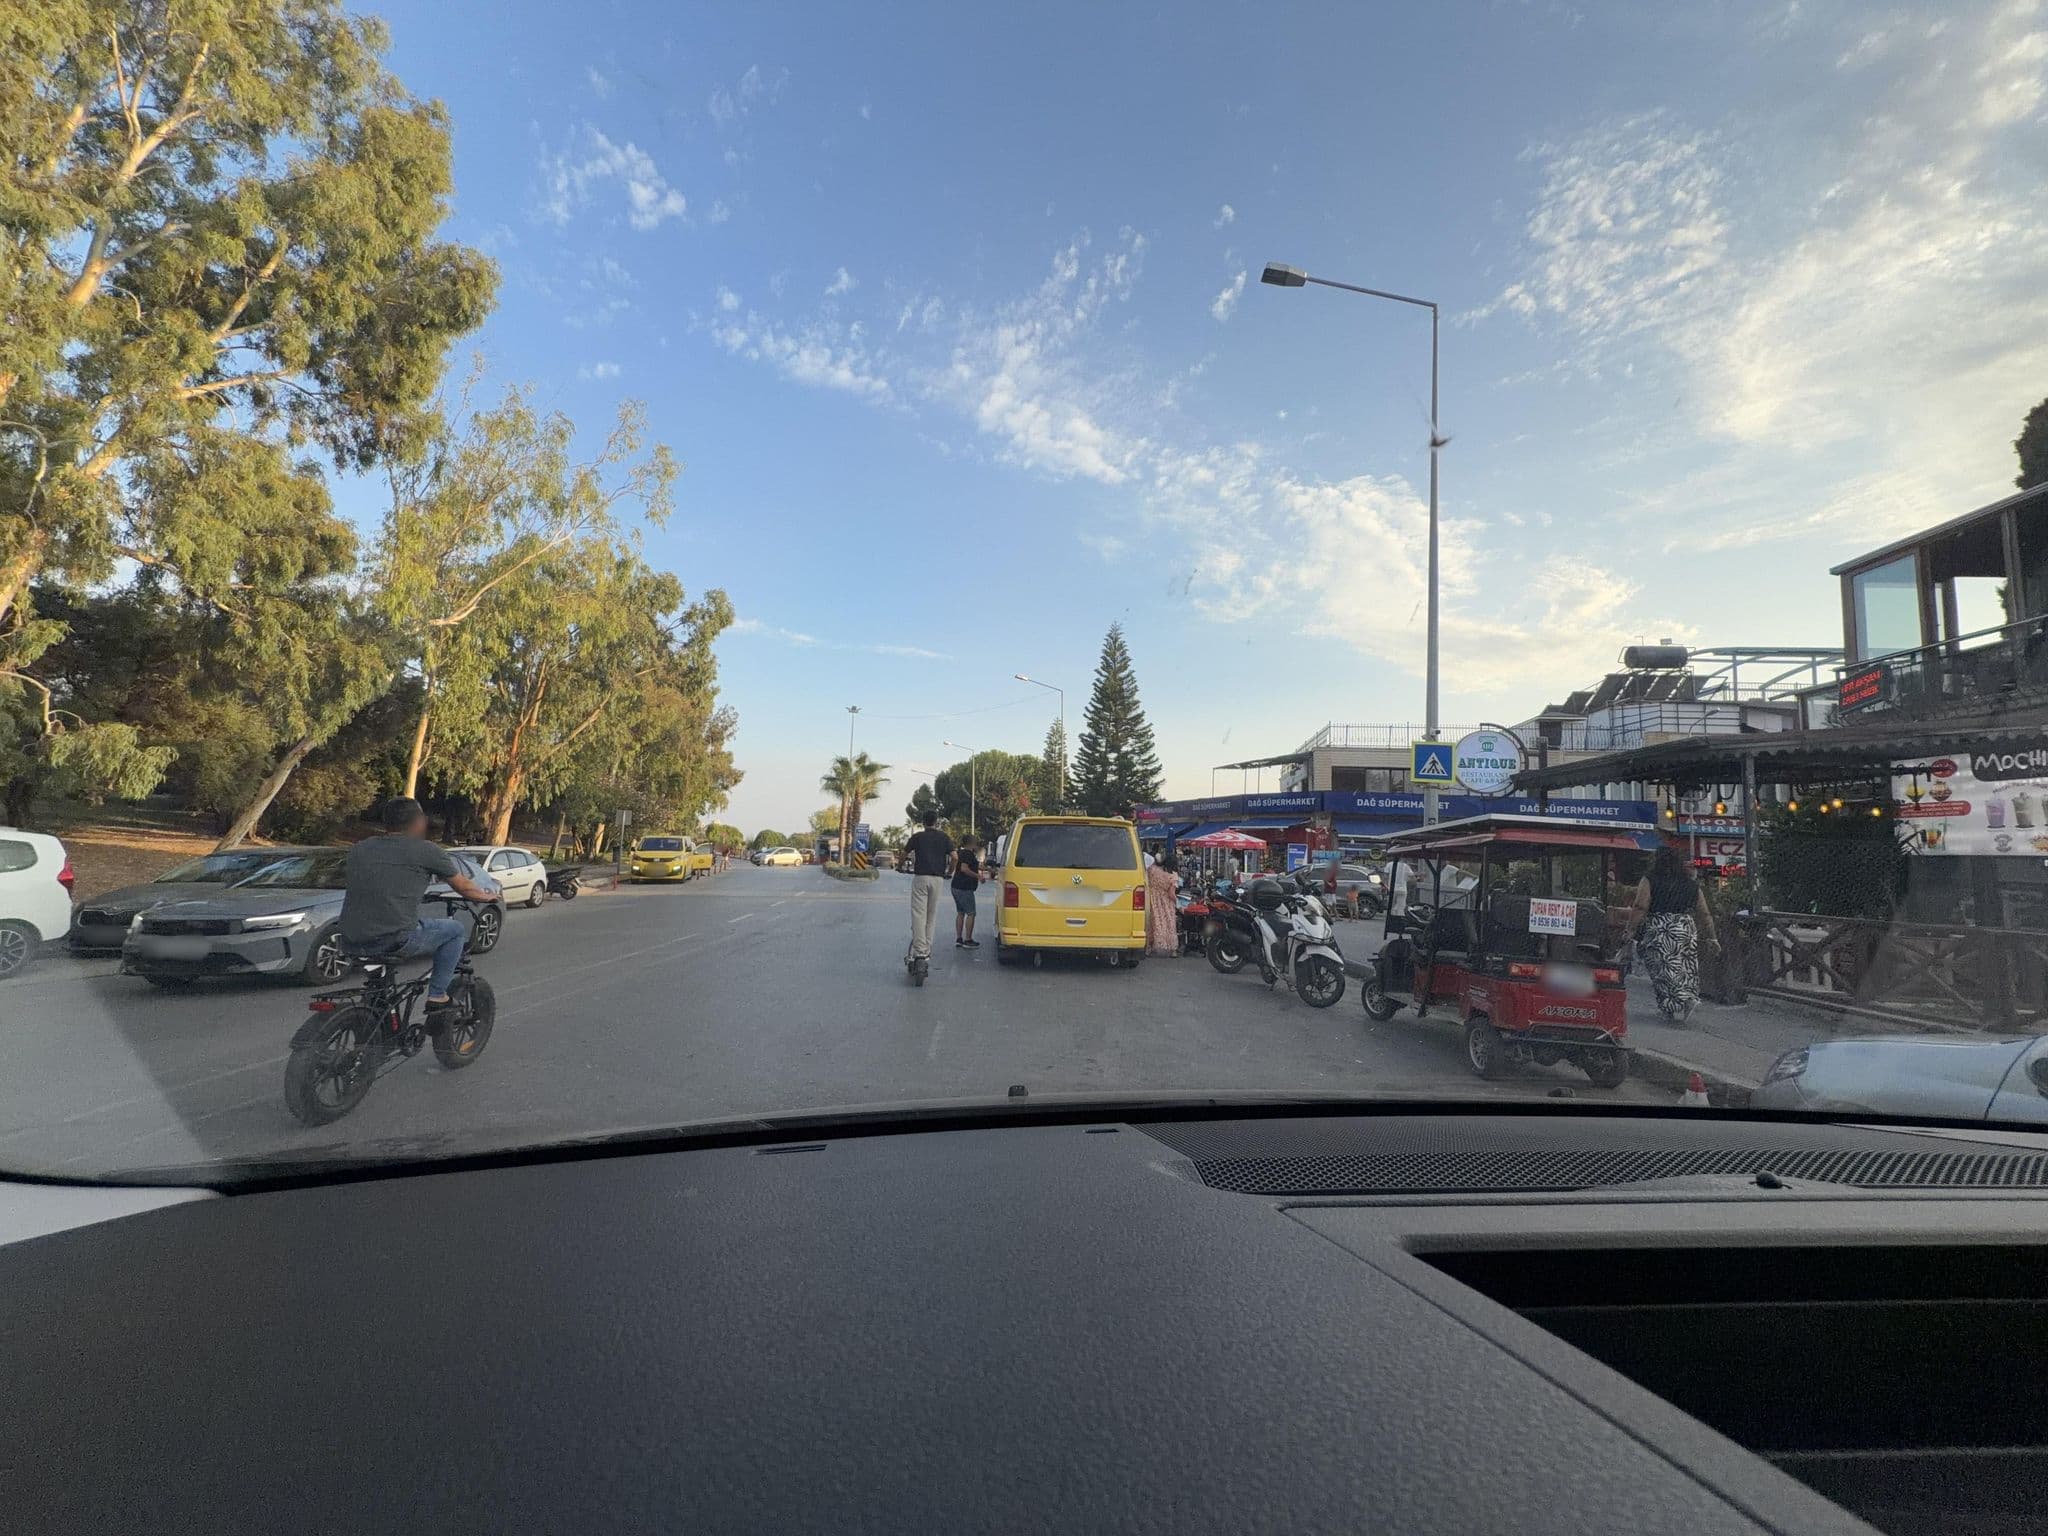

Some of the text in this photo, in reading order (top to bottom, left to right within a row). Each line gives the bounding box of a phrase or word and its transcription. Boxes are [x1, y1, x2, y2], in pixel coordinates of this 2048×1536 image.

[1457, 757, 1517, 770] ANTIQUE
[1974, 749, 2048, 772] MOCHI
[1247, 797, 1316, 807] DAĞ SÜPERMARKET
[1356, 798, 1450, 810] DAĞ SÜPERMAET
[1519, 804, 1540, 813] DAĞ
[1548, 903, 1560, 916] RENT
[1566, 904, 1576, 918] CAR
